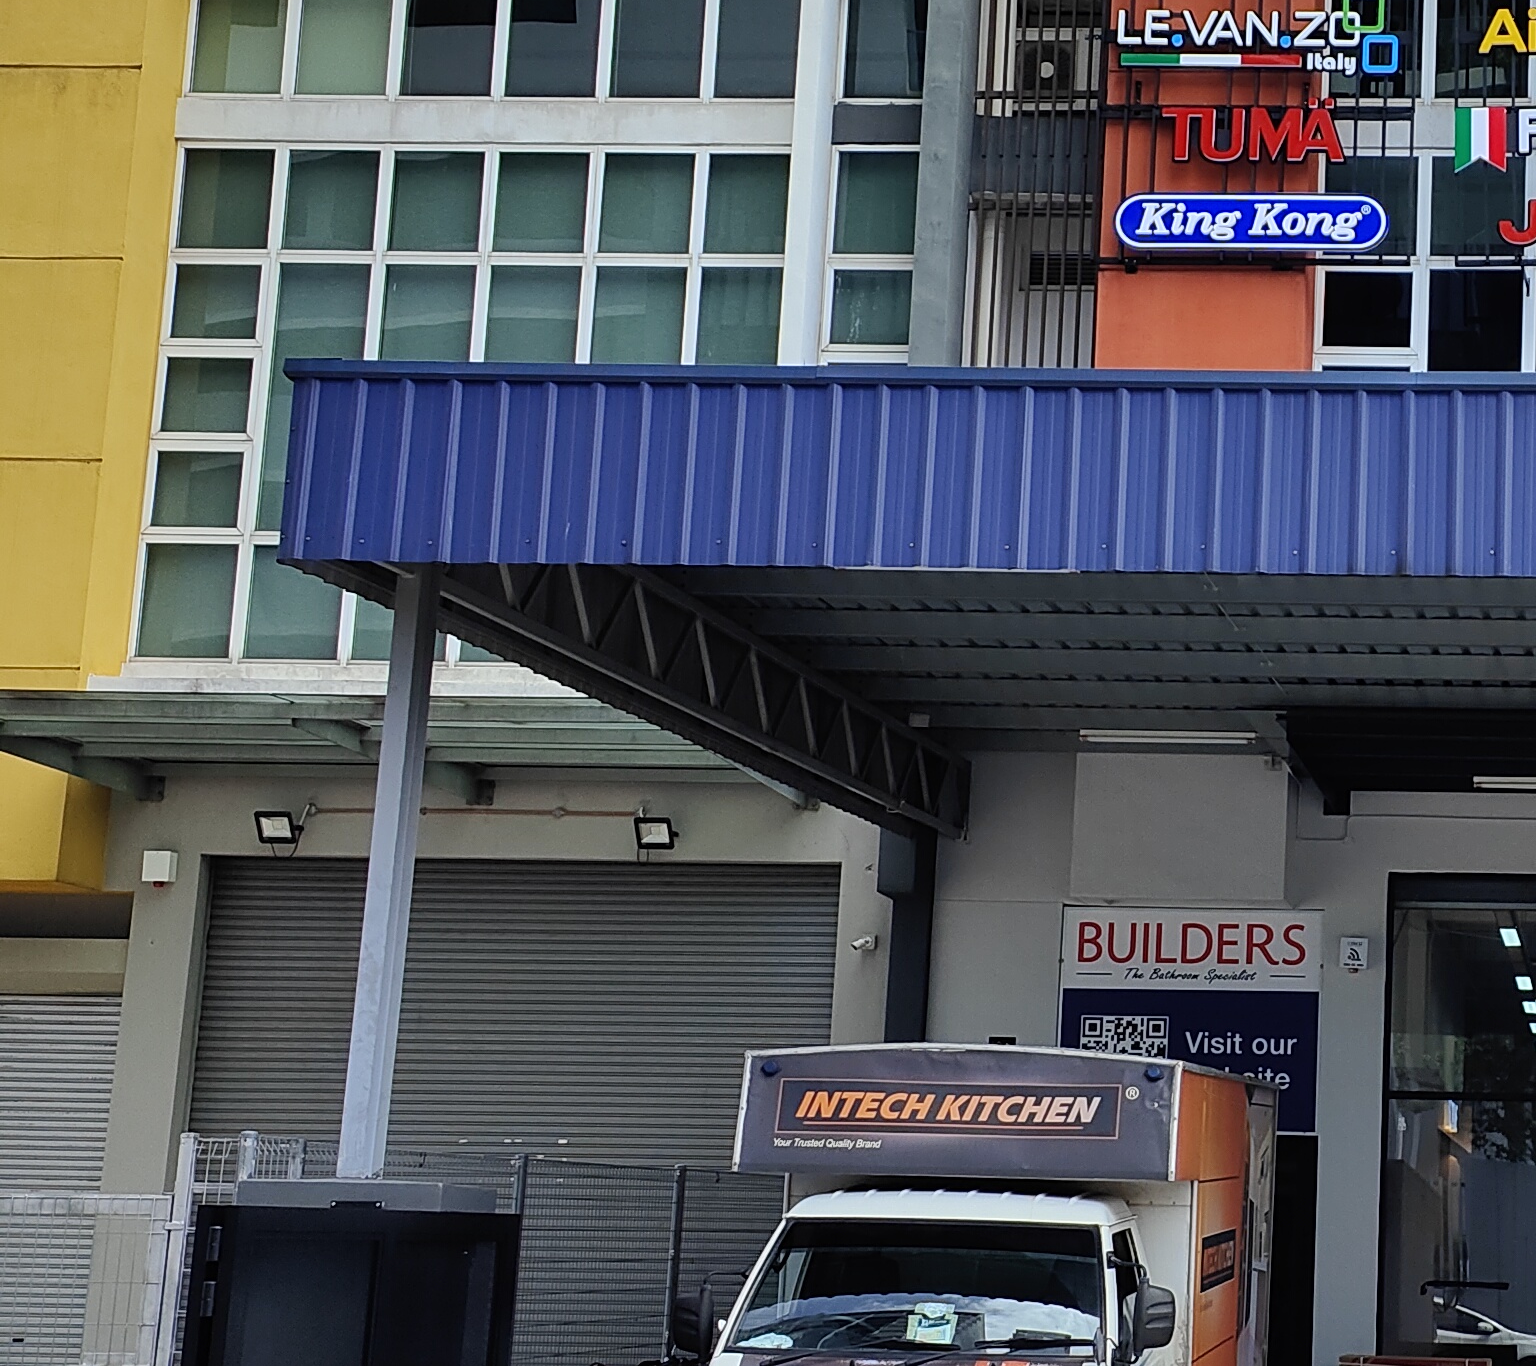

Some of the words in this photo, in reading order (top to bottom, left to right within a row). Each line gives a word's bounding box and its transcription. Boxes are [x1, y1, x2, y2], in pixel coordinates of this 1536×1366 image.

[1306, 51, 1358, 77] Italy
[1133, 202, 1242, 242] King
[1076, 921, 1307, 967] BUILDERS
[1123, 968, 1145, 981] The
[1149, 969, 1200, 982] Bathroom
[1203, 969, 1258, 985] Specialist
[1185, 1031, 1244, 1055] Visit
[1252, 1036, 1298, 1055] our
[795, 1090, 937, 1121] INTECH
[935, 1095, 1103, 1124] KITCHEN
[773, 1137, 793, 1148] Your
[793, 1138, 824, 1149] Trusted
[825, 1138, 855, 1150] Quality
[855, 1139, 882, 1149] Brand
